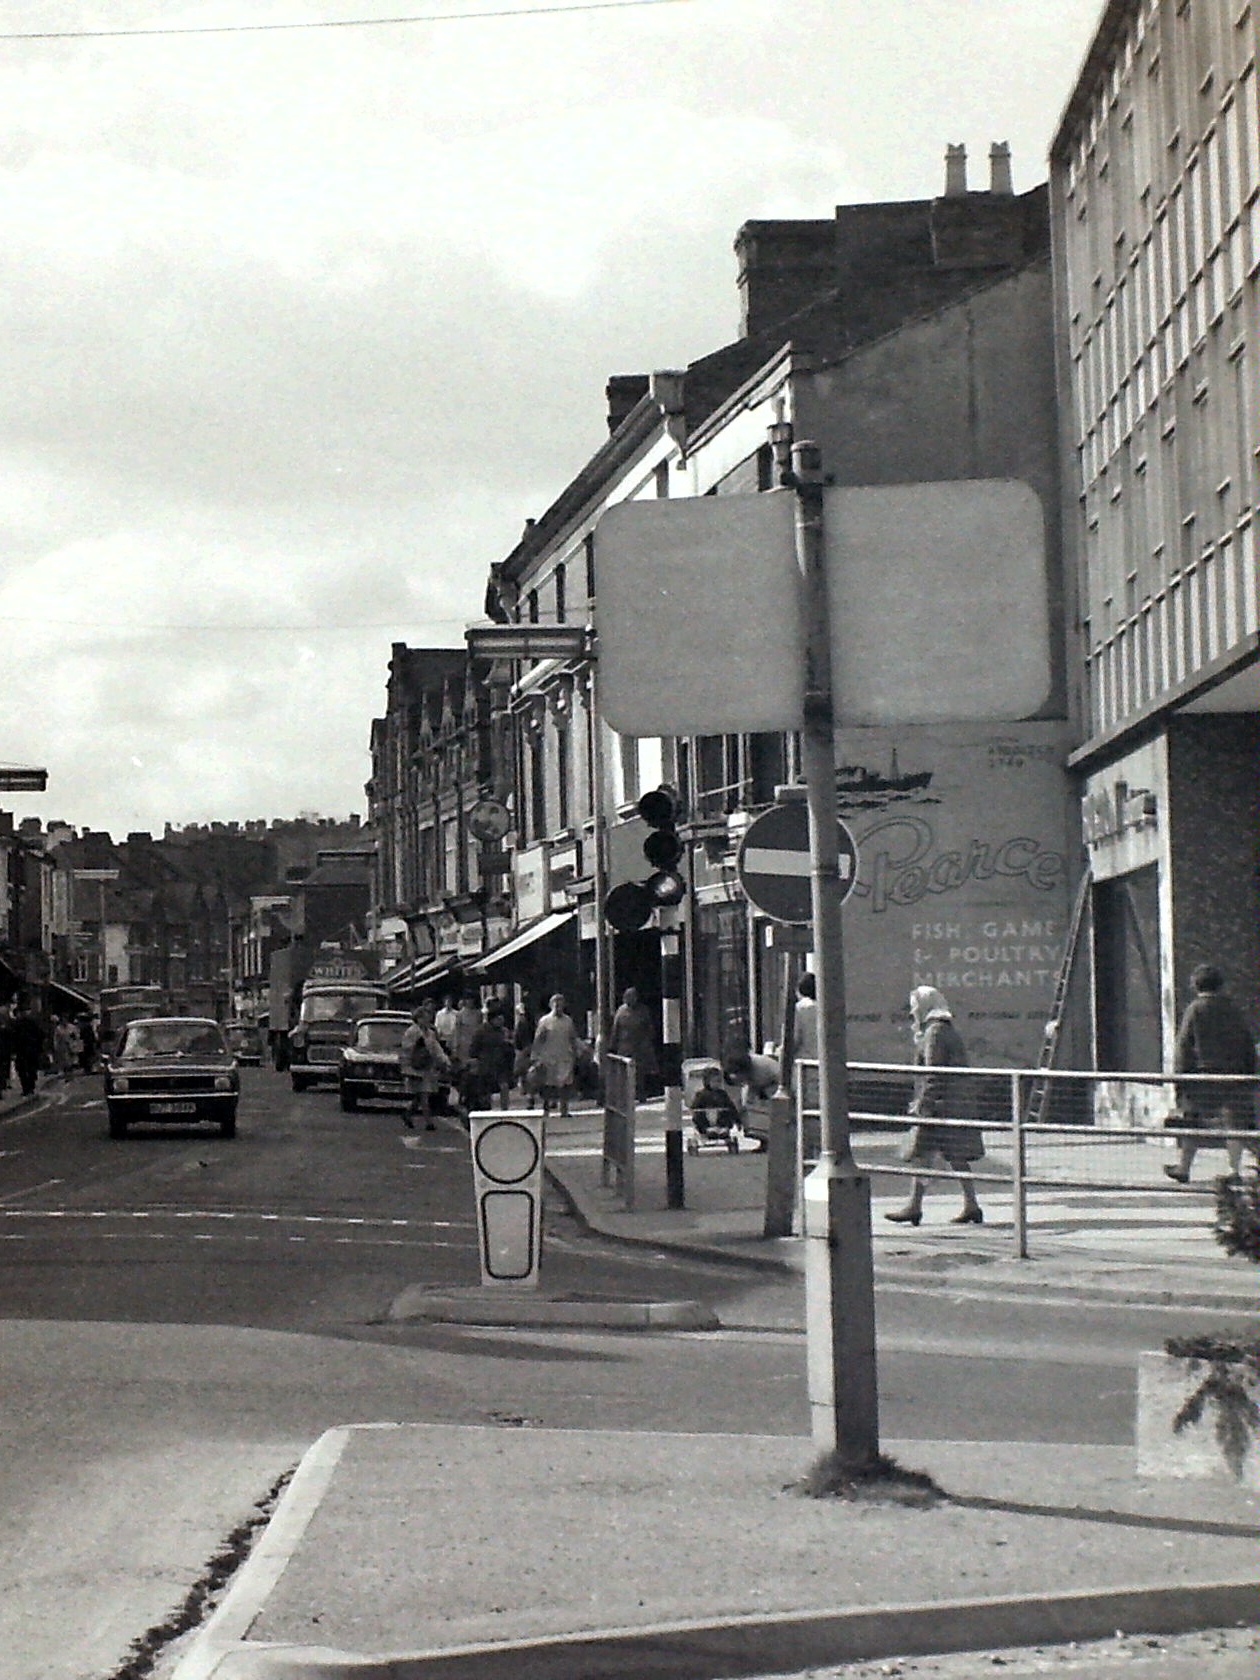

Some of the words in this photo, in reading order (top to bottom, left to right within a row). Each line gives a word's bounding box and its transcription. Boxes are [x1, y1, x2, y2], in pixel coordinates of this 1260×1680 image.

[853, 816, 1063, 914] Pearce
[912, 922, 961, 940] FISH
[983, 920, 1059, 938] GAME
[949, 945, 1062, 963] POULTRY
[913, 970, 1063, 988] MERCHANTS
